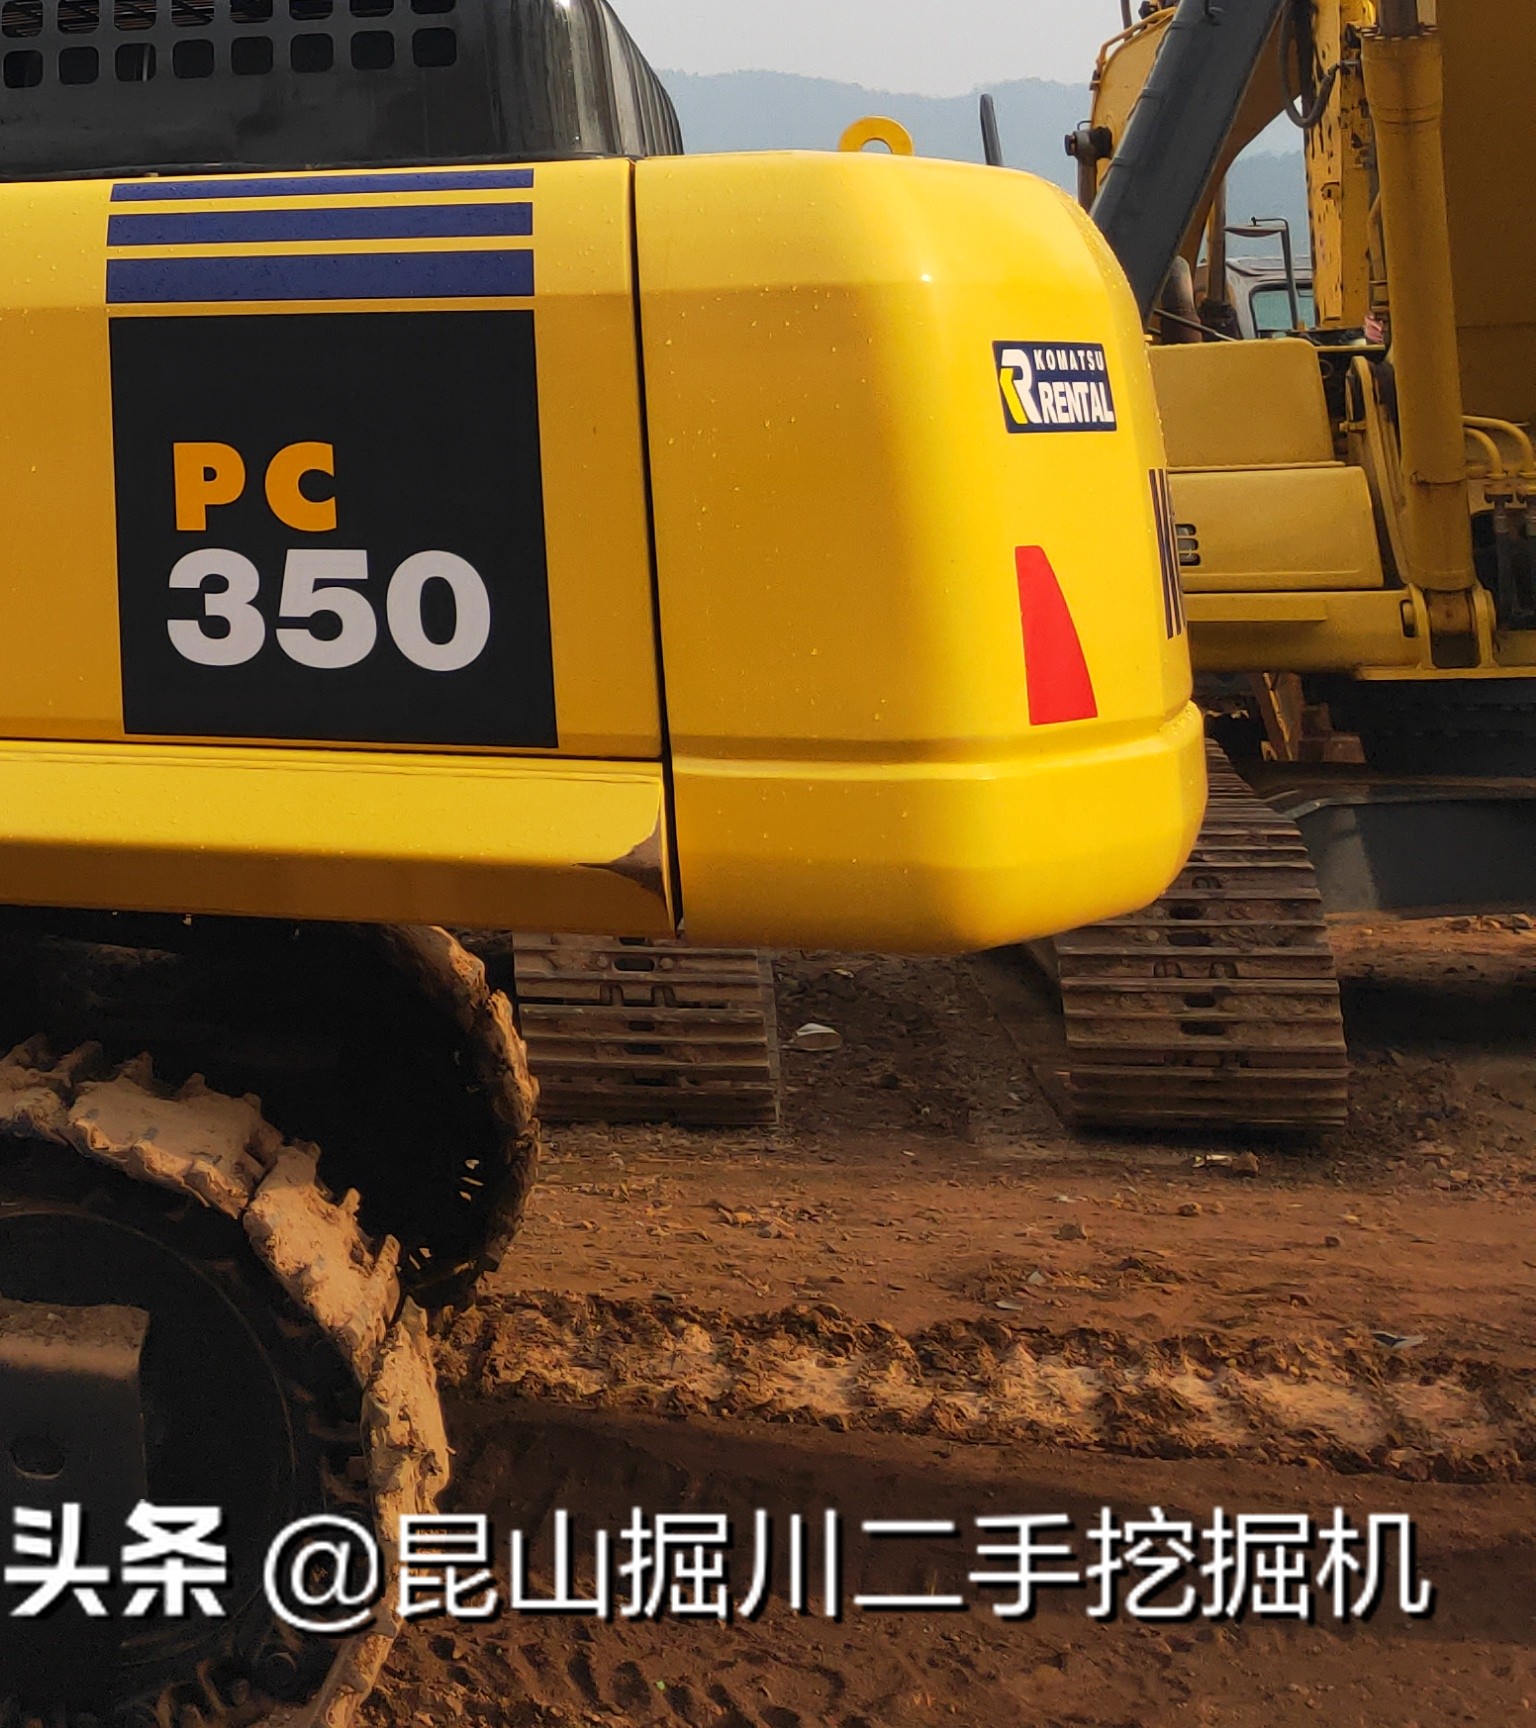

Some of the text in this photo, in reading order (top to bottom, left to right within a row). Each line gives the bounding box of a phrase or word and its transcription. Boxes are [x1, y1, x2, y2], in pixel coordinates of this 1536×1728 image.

[1033, 349, 1104, 371] KOMATSU
[1037, 381, 1115, 424] RENTAL
[173, 441, 337, 532] PC
[166, 547, 491, 672] 350
